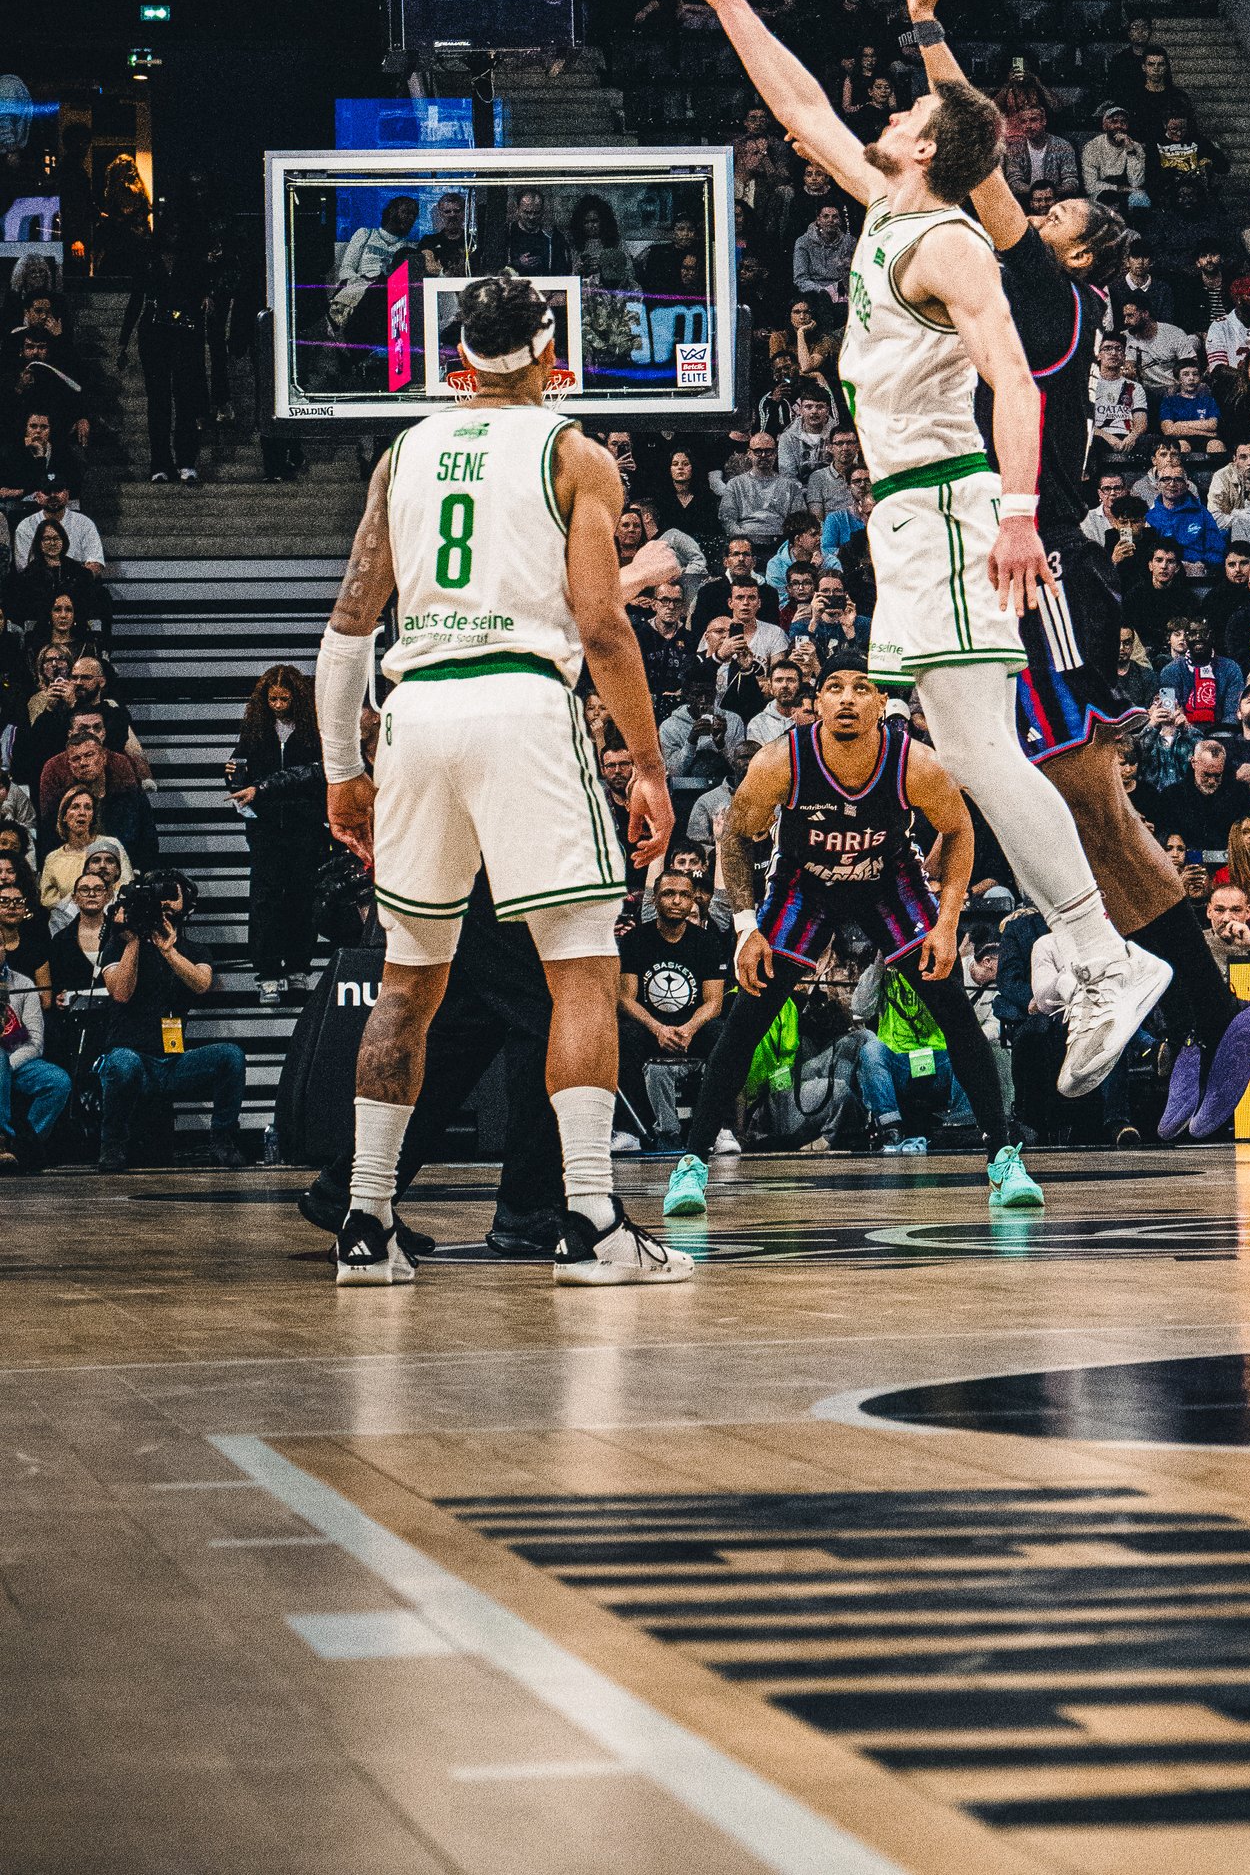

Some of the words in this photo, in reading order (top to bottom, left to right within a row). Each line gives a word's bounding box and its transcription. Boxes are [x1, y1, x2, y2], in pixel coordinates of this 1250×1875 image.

[682, 372, 708, 383] ÉLITE
[289, 407, 334, 417] SPALDING
[436, 452, 489, 482] SENE
[435, 493, 474, 589] 8
[385, 712, 393, 746] 8
[809, 827, 887, 852] PARIS
